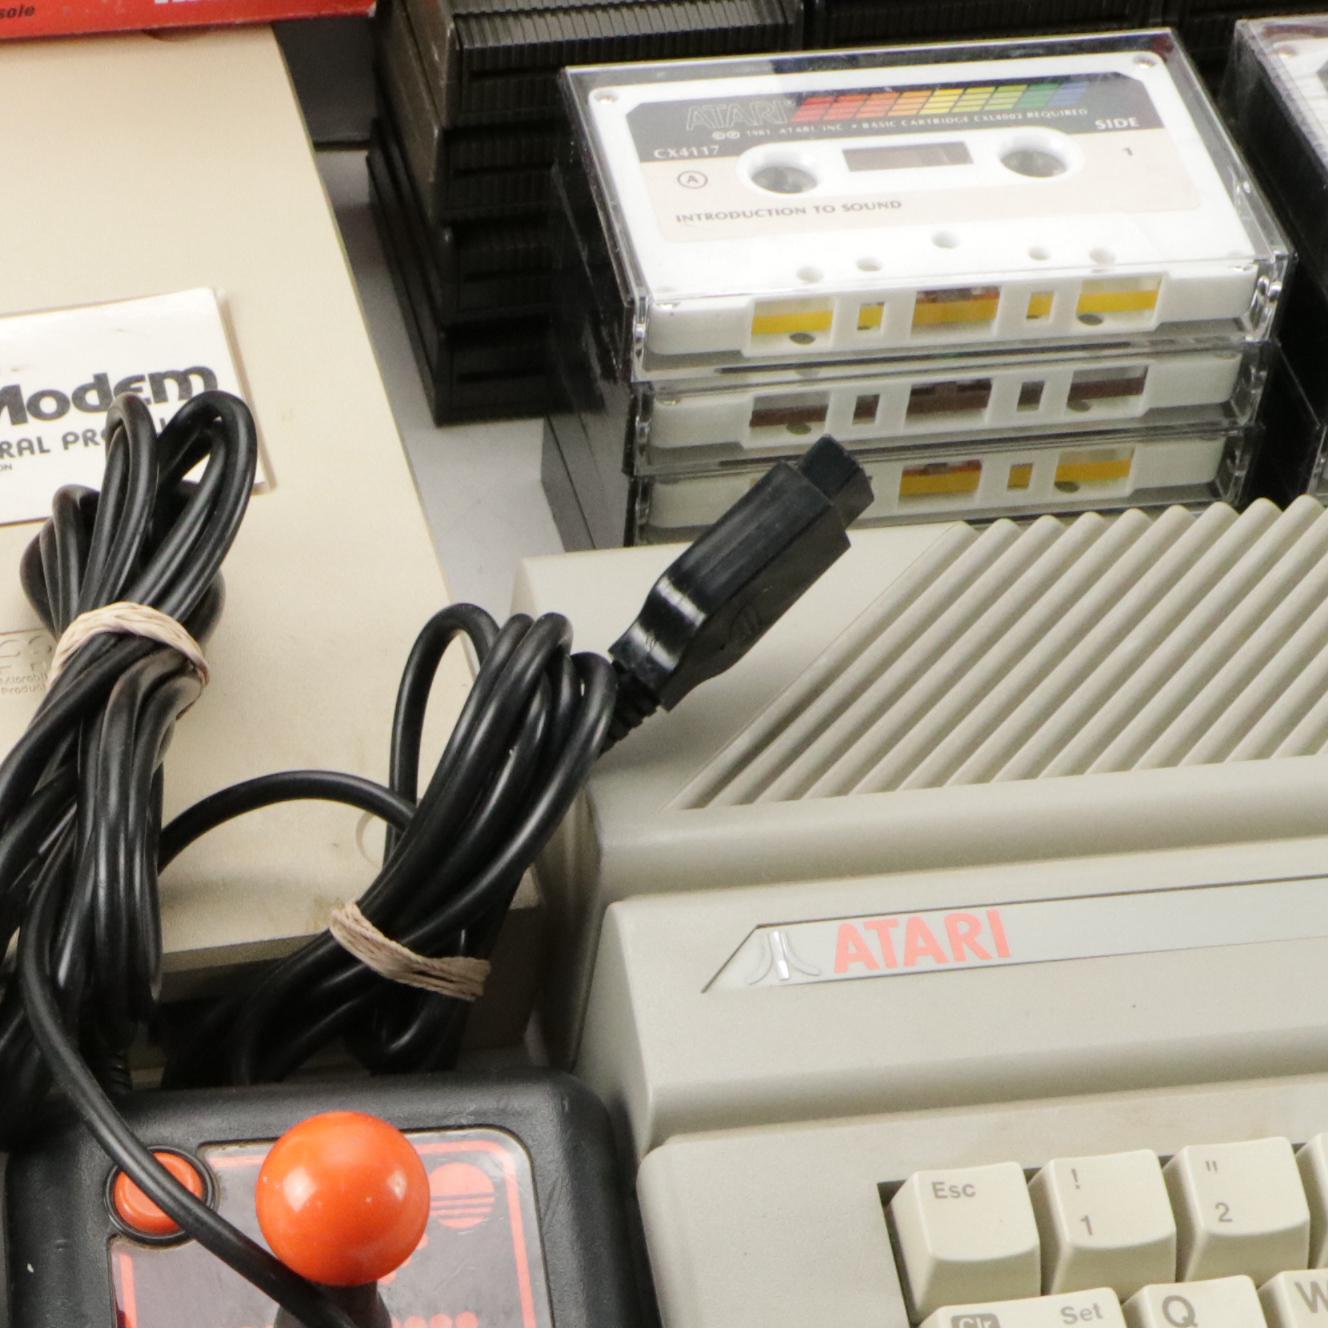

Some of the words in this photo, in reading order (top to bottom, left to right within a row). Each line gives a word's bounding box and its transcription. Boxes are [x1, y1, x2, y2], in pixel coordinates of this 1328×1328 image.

[862, 120, 897, 130] BASIC
[901, 115, 969, 128] CARTRIDGE
[1026, 107, 1089, 119] REQUIRED
[1093, 116, 1141, 130] SIDE
[653, 145, 720, 160] CX4117
[676, 206, 807, 224] INTRODUCTION
[812, 204, 836, 214] TO
[841, 200, 902, 213] SOUND
[833, 908, 1012, 974] ATARI
[931, 1180, 976, 1200] Esc
[1069, 1168, 1081, 1190] !
[1214, 1201, 1233, 1224] 2
[1079, 1213, 1093, 1237] 1
[1059, 1302, 1104, 1326] Set
[1161, 1293, 1198, 1328] Q
